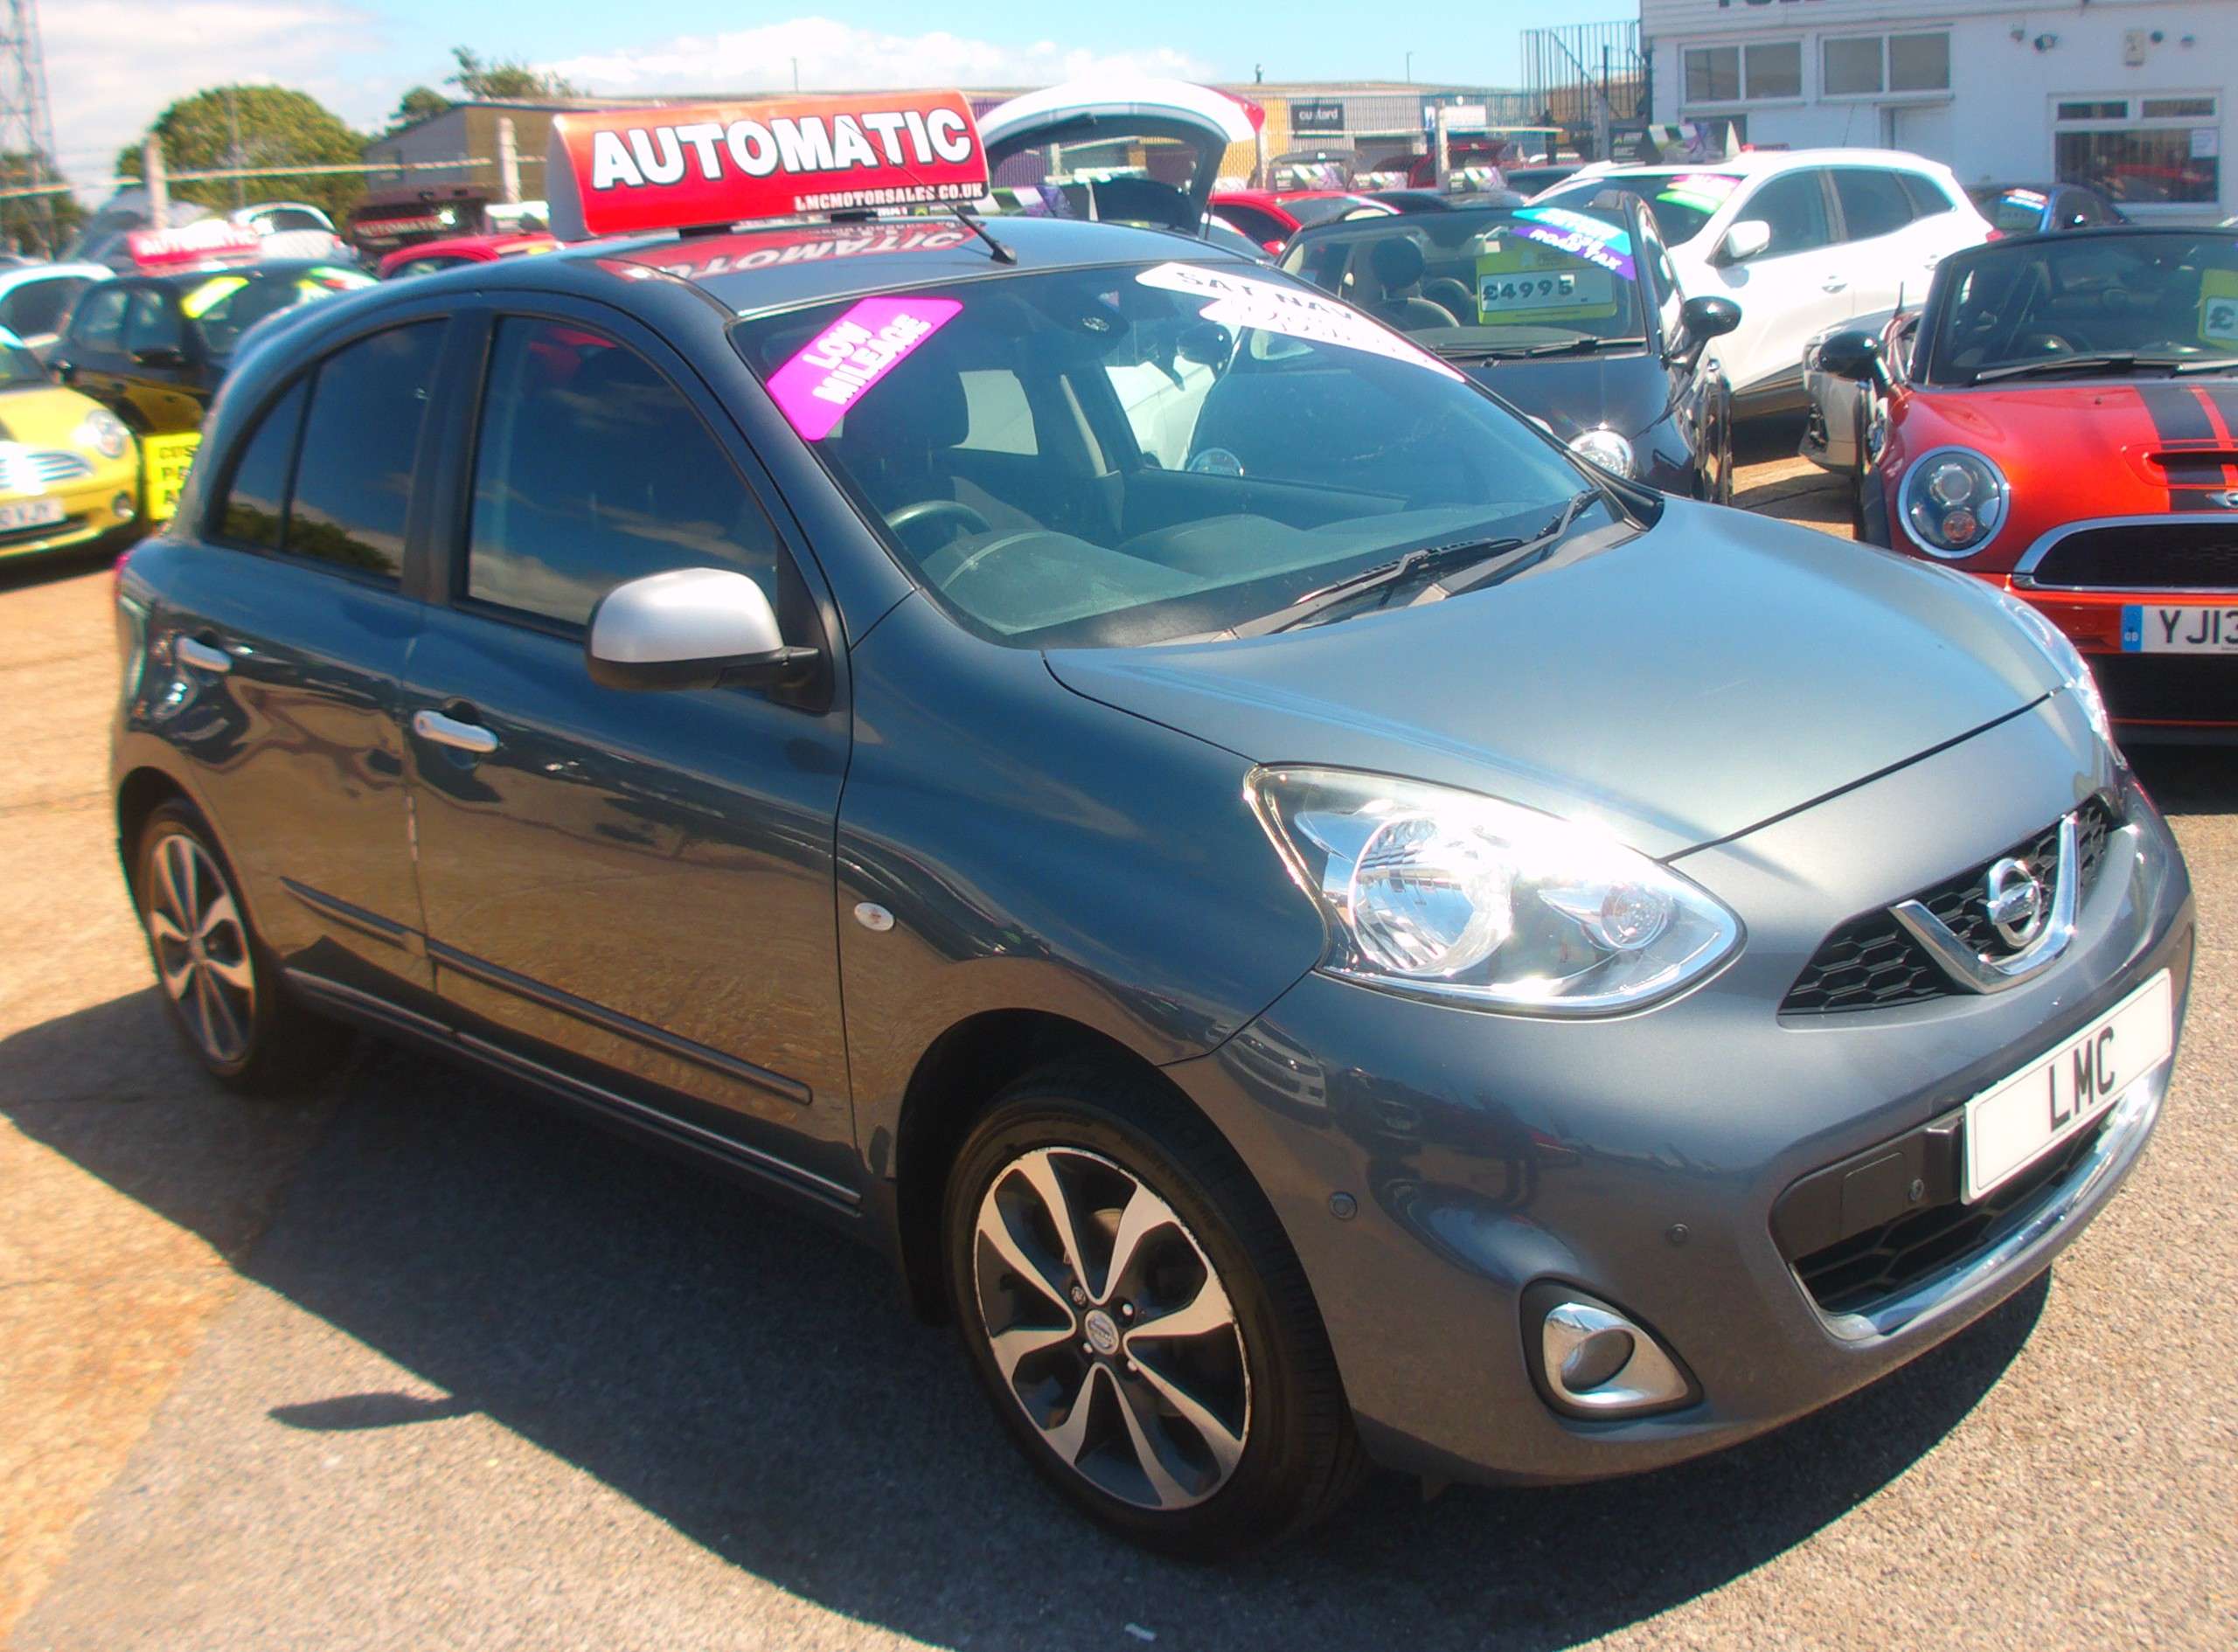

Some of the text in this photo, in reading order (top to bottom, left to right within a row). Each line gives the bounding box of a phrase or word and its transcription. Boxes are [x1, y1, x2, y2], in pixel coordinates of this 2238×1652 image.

[591, 108, 972, 190] AUTOMATIC
[1483, 277, 1574, 302] £4995
[802, 320, 876, 370] LOW
[811, 312, 933, 406] MILEAGE
[2048, 1026, 2116, 1134] LMC
